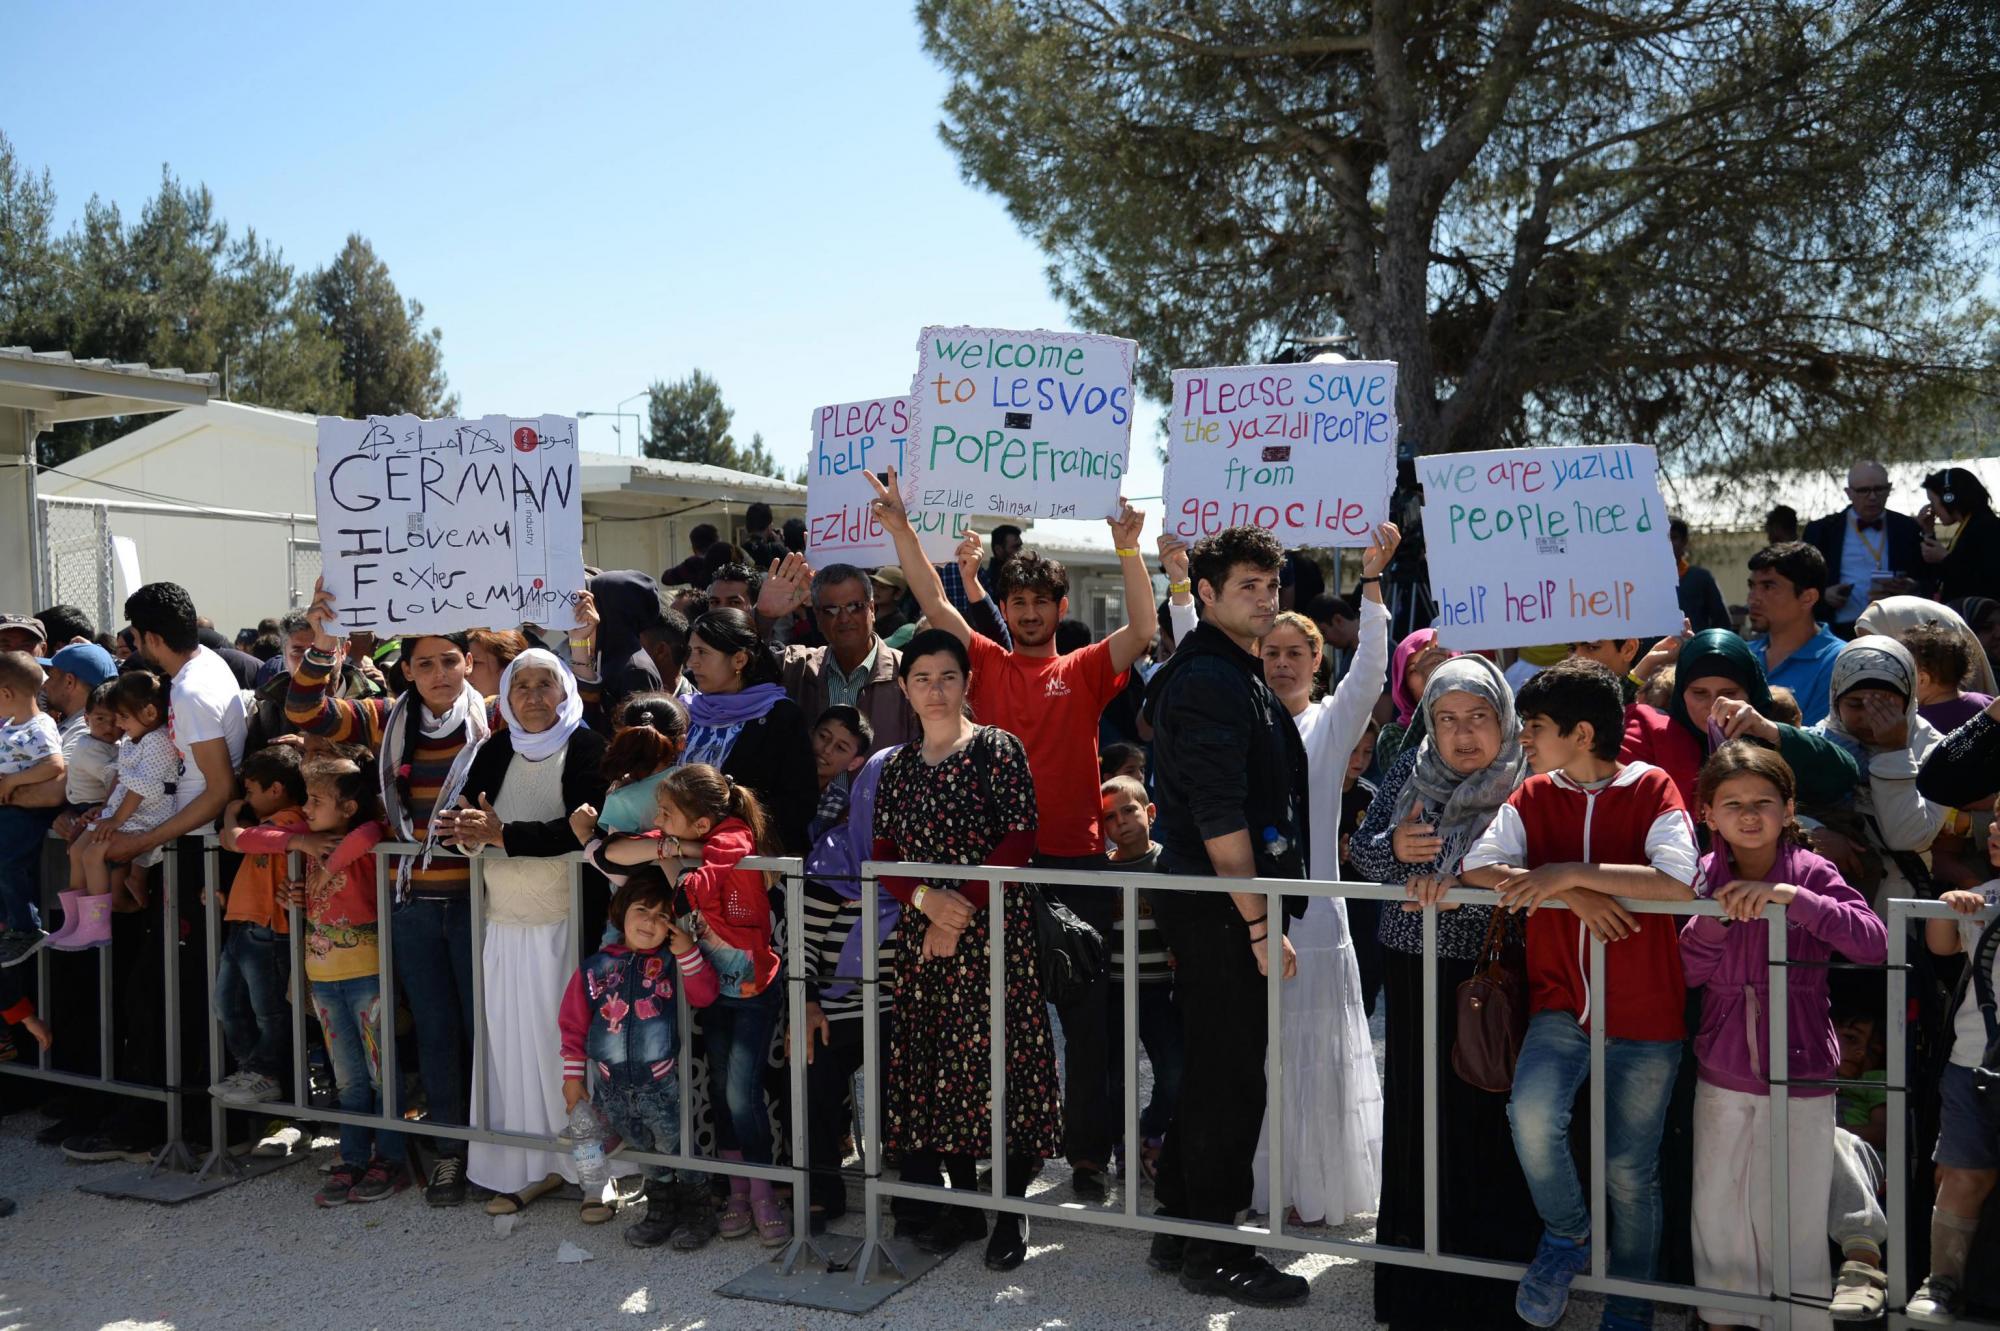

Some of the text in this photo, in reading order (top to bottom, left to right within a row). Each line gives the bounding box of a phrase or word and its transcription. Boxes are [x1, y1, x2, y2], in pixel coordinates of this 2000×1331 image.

[930, 372, 977, 404] to
[1181, 417, 1220, 443] the
[329, 454, 574, 514] GERMAN
[1224, 456, 1294, 492] from
[1487, 460, 1545, 493] are
[525, 509, 535, 546] industry
[1176, 498, 1371, 537] genocide
